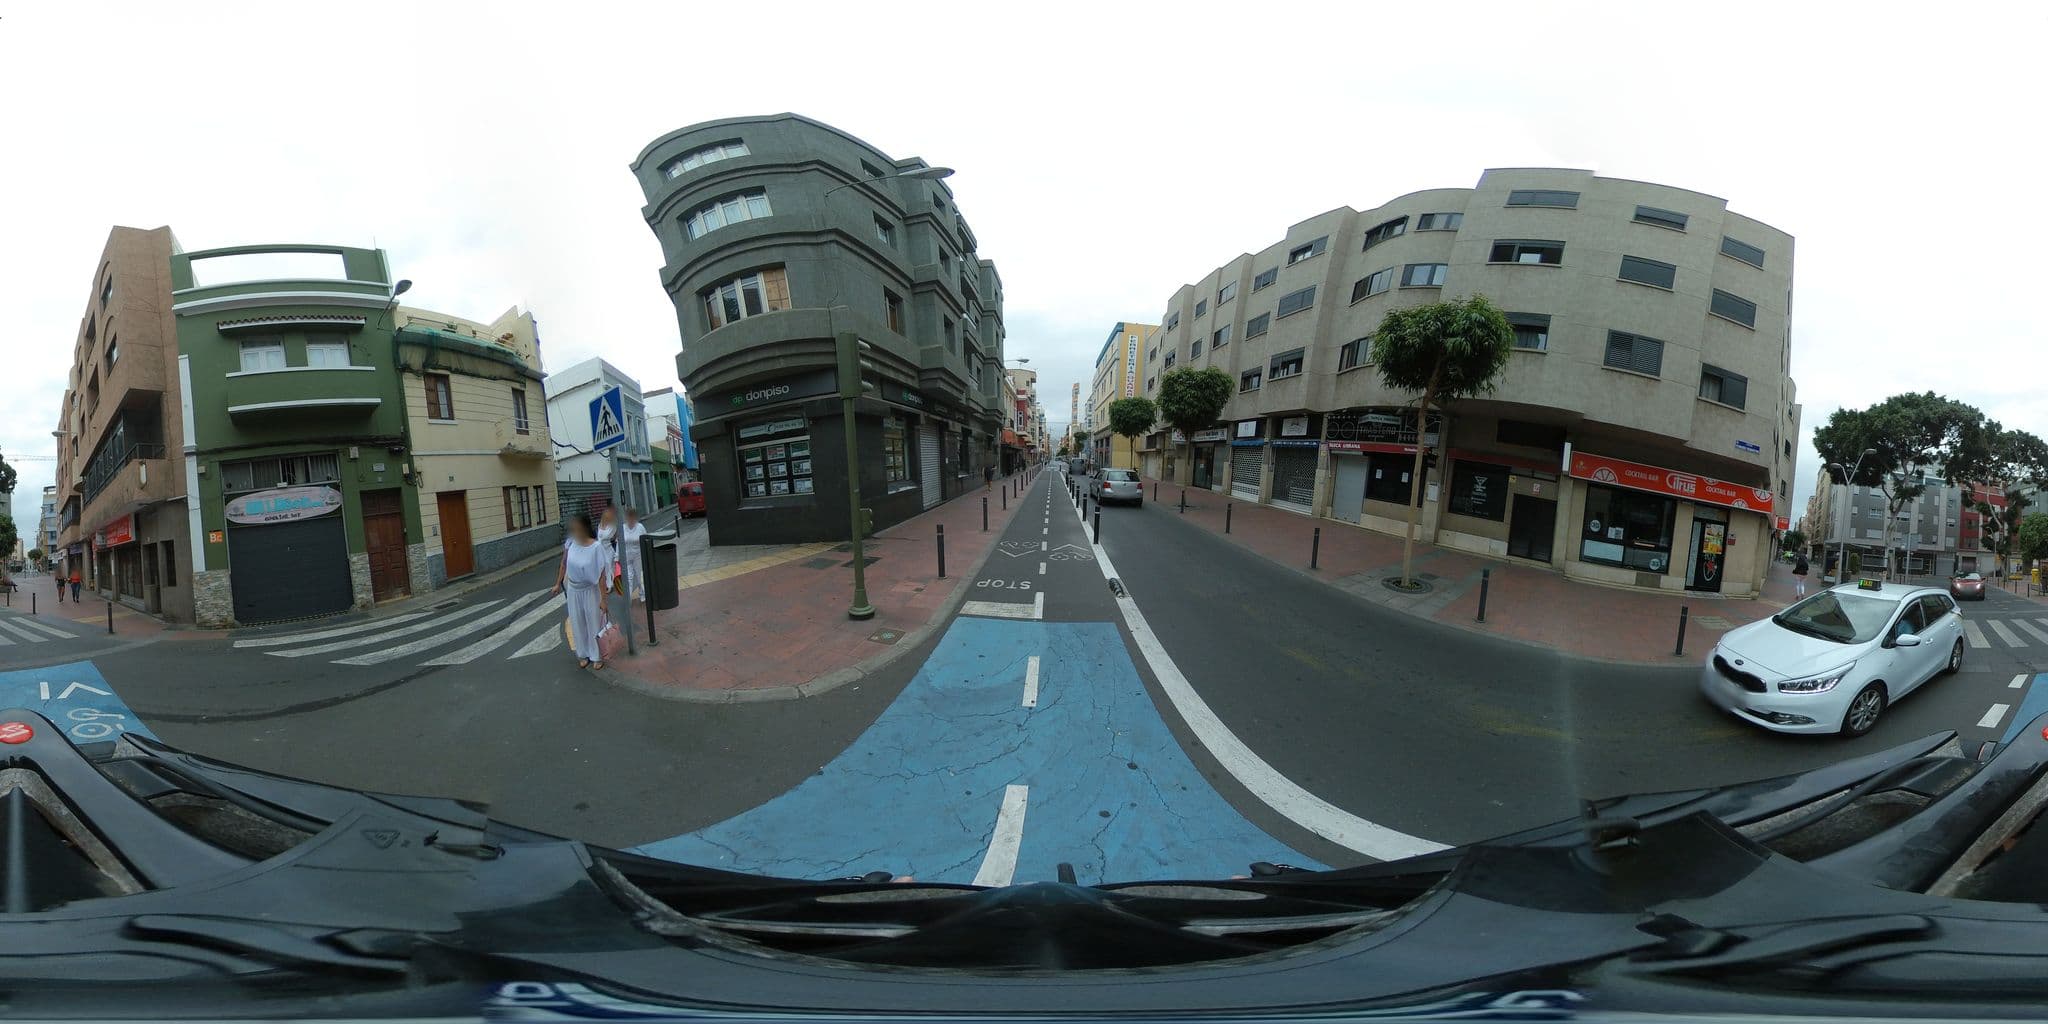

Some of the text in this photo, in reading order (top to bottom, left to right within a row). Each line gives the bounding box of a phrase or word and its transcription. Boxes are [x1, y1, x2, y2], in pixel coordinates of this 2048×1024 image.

[746, 385, 790, 400] donpiso
[1625, 469, 1648, 480] COCKTAIL
[1666, 473, 1696, 495] Citrus
[1705, 485, 1727, 495] COCKTAIL
[976, 579, 1032, 590] STOP
